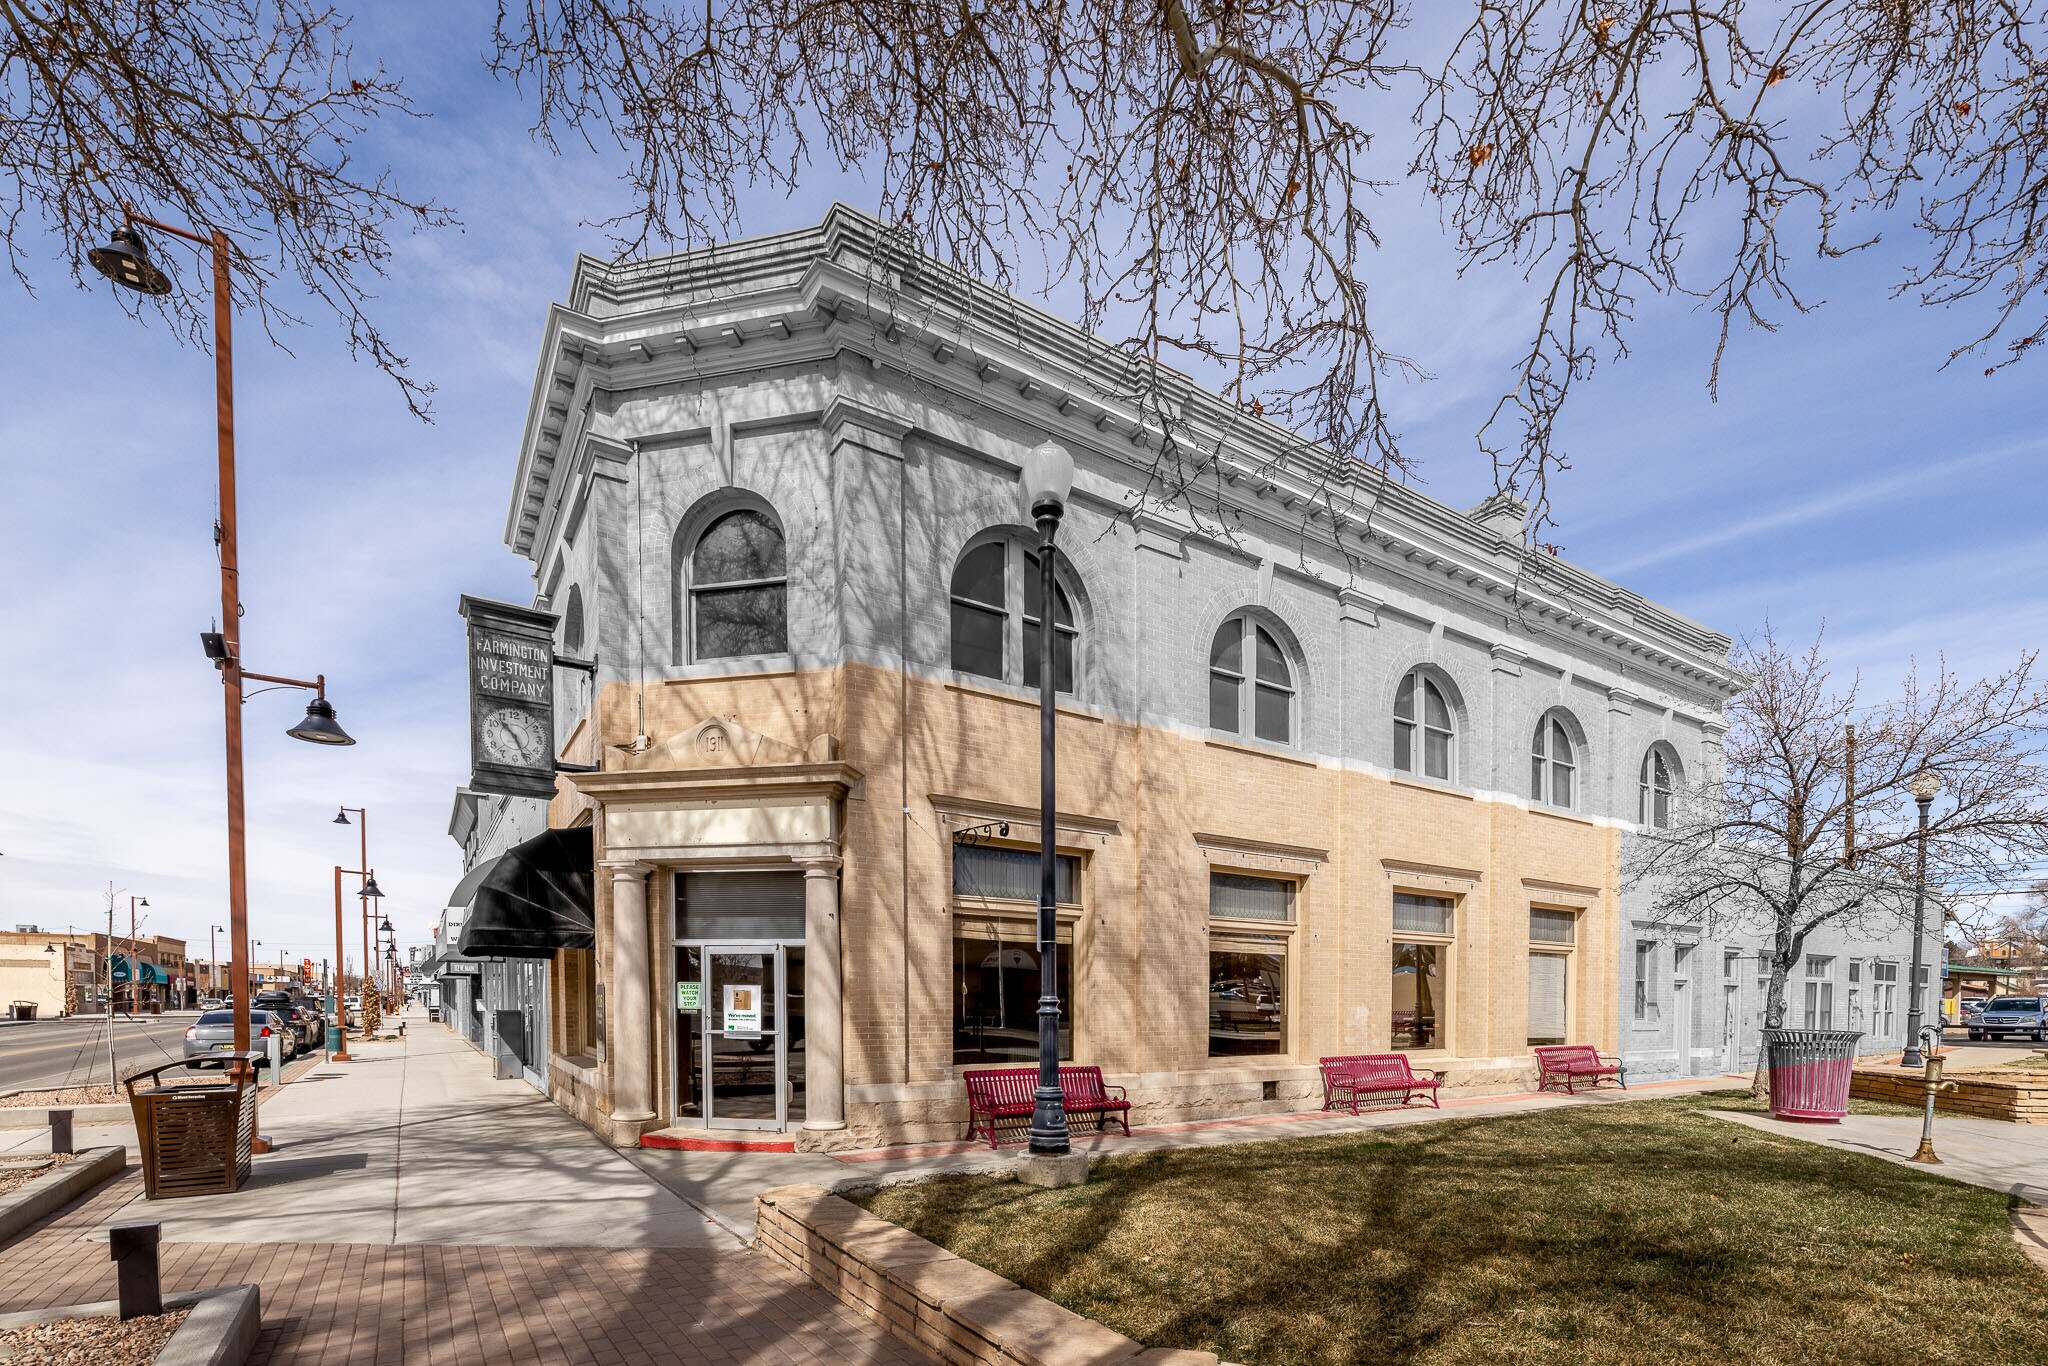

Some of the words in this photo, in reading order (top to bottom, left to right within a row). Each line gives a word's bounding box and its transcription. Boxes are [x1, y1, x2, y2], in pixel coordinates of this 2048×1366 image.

[477, 638, 548, 663] FARMINGTON
[477, 655, 549, 680] INVESTMENT
[480, 675, 545, 698] COMPANY
[499, 712, 506, 721] 11
[510, 711, 520, 720] 12
[525, 716, 529, 724] 1
[489, 719, 499, 728] 10
[533, 724, 539, 734] 2
[487, 730, 494, 738] 9
[490, 740, 497, 749] 8
[536, 735, 543, 745] 3
[706, 736, 724, 753] 1911
[500, 749, 506, 759] 7
[532, 746, 540, 755] 4
[512, 754, 518, 763] 6
